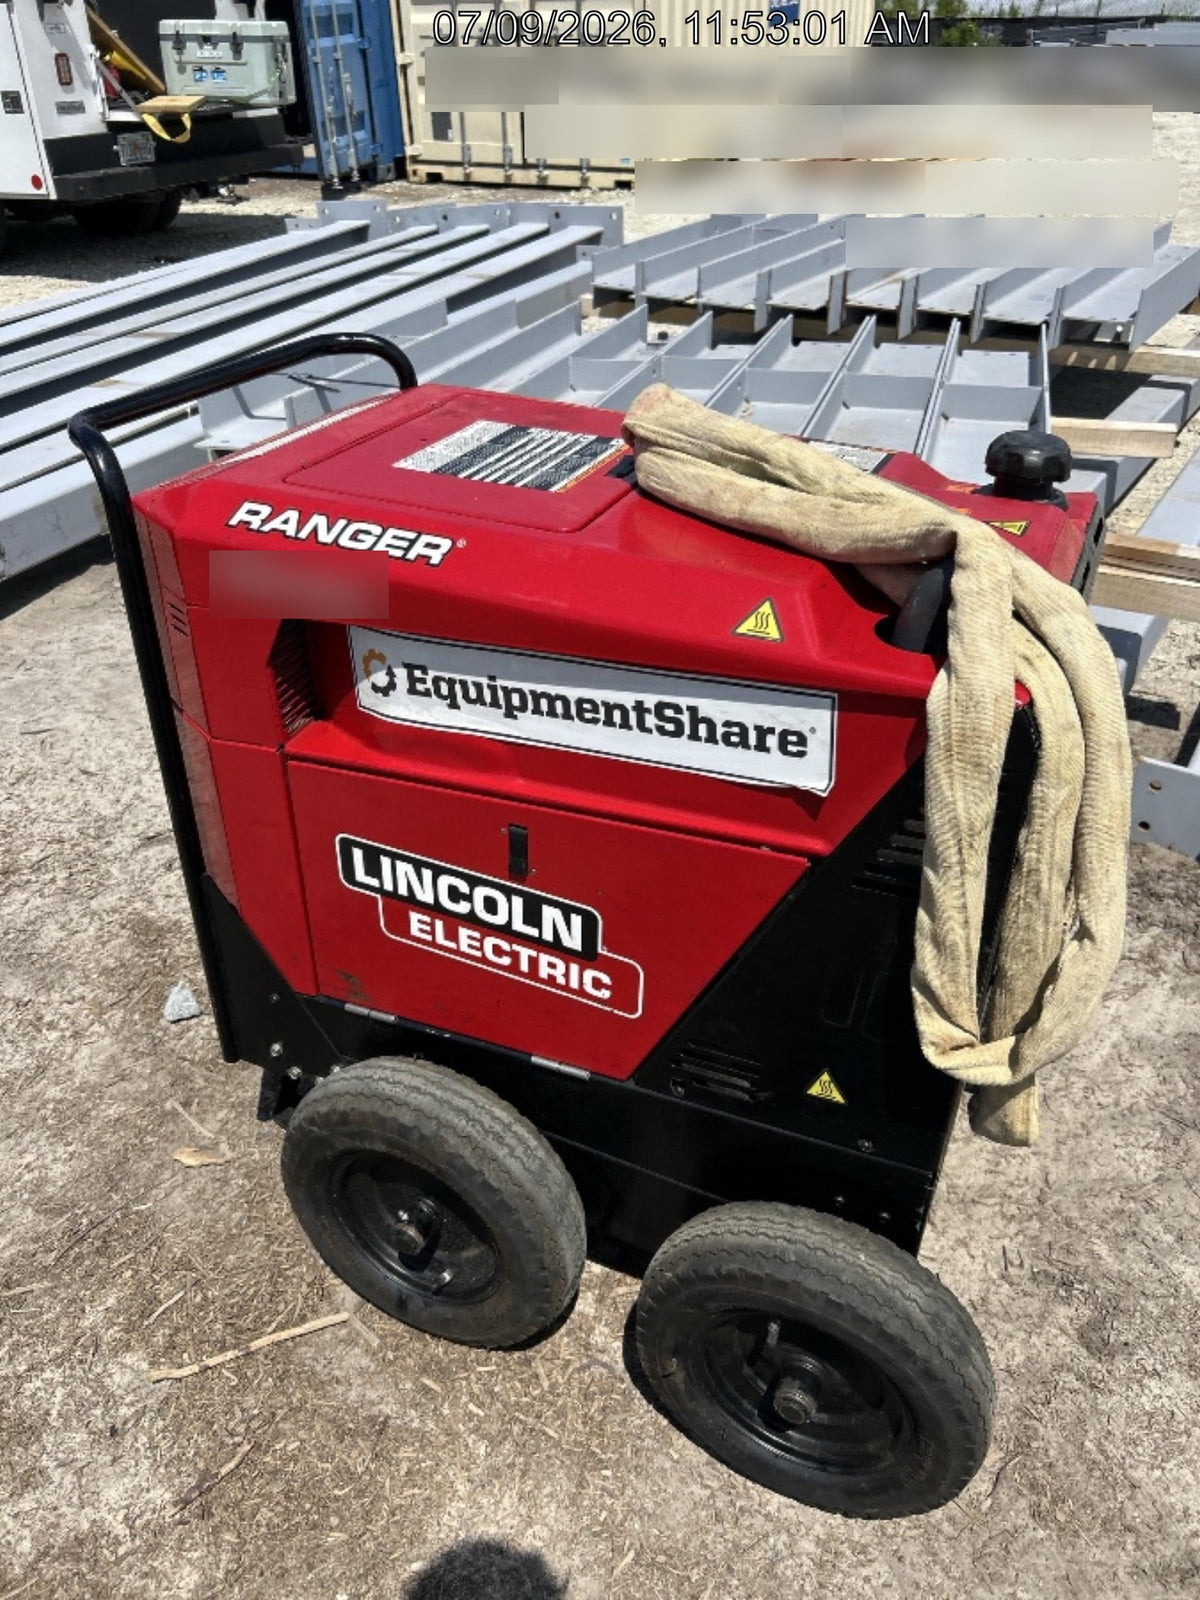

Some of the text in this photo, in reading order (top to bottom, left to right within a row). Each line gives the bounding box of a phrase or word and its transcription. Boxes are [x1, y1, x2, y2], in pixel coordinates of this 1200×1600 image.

[226, 500, 454, 567] RANGER
[402, 662, 809, 758] EquipmentShare
[351, 846, 583, 952] LINCOLN
[408, 910, 612, 999] ELECTRIC
